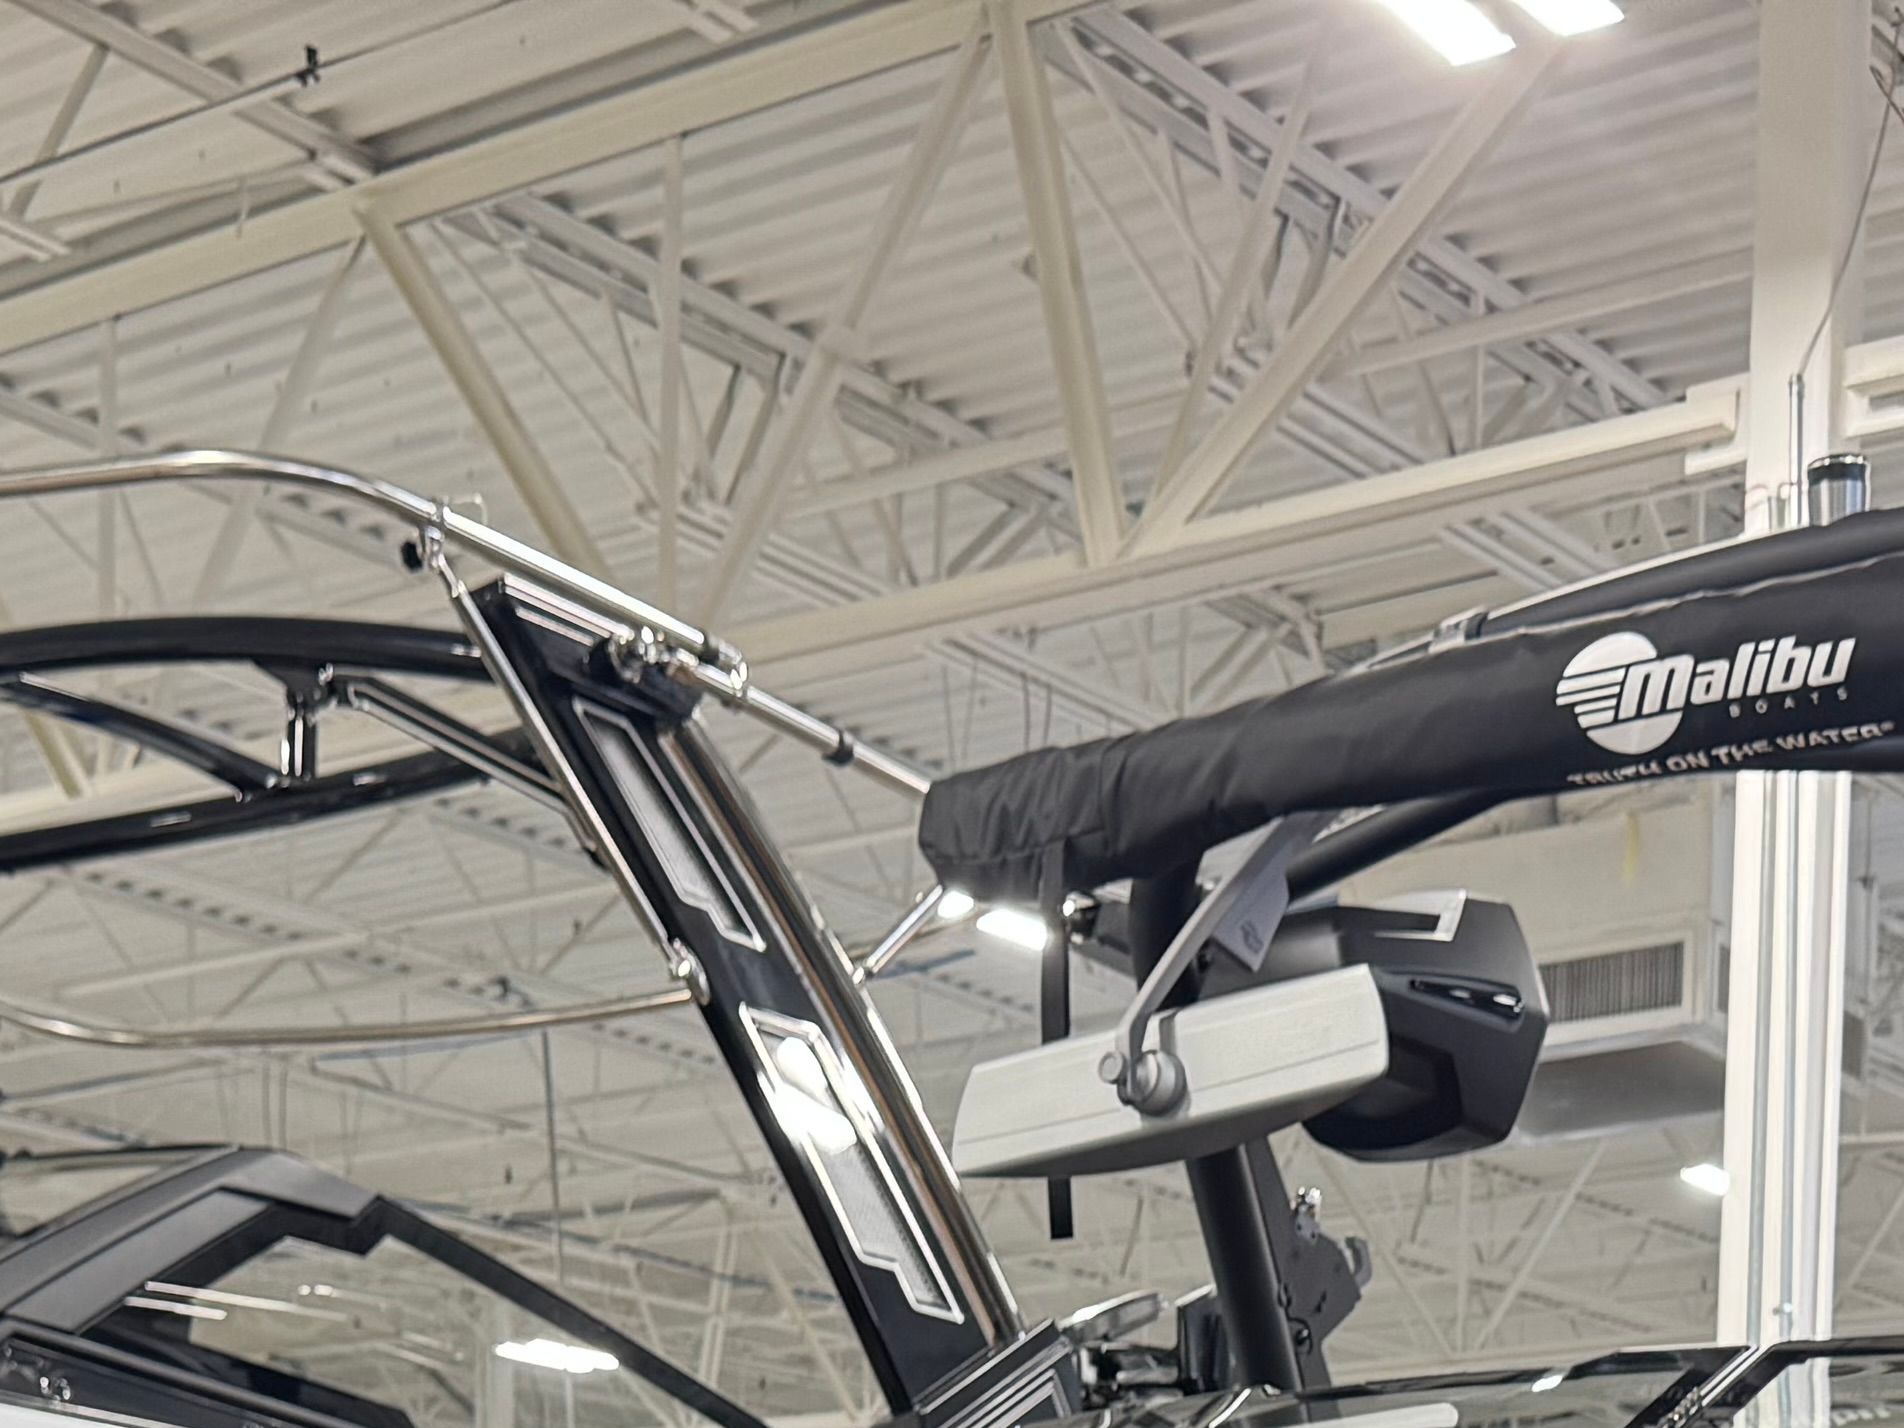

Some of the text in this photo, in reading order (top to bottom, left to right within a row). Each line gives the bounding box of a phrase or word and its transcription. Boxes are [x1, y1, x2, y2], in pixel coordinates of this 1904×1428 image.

[1728, 688, 1848, 718] BOATS
[1665, 750, 1709, 771] ON
[1710, 738, 1774, 764] THE
